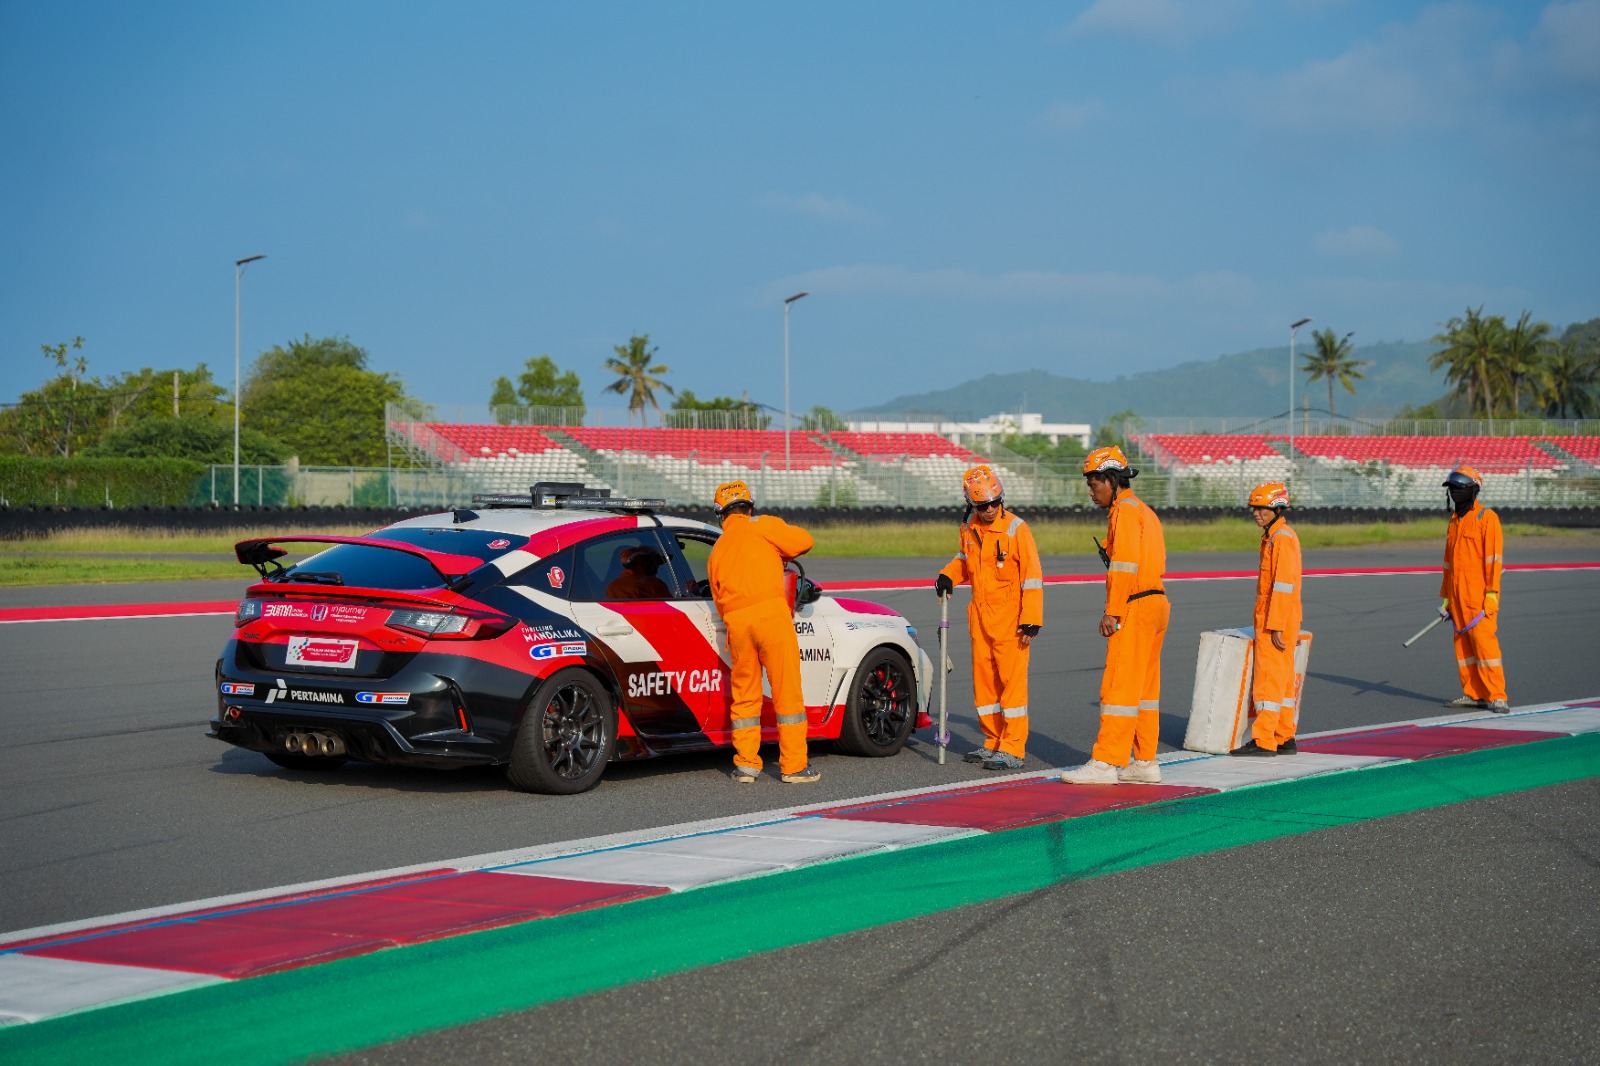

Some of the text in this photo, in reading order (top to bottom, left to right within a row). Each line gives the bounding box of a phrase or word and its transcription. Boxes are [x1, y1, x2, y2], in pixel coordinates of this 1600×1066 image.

[793, 622, 815, 634] GPA
[523, 629, 582, 642] MANDALIKA
[799, 648, 831, 662] AMINA
[628, 668, 722, 697] SAFETY CAR
[291, 690, 344, 704] PERTAMINA
